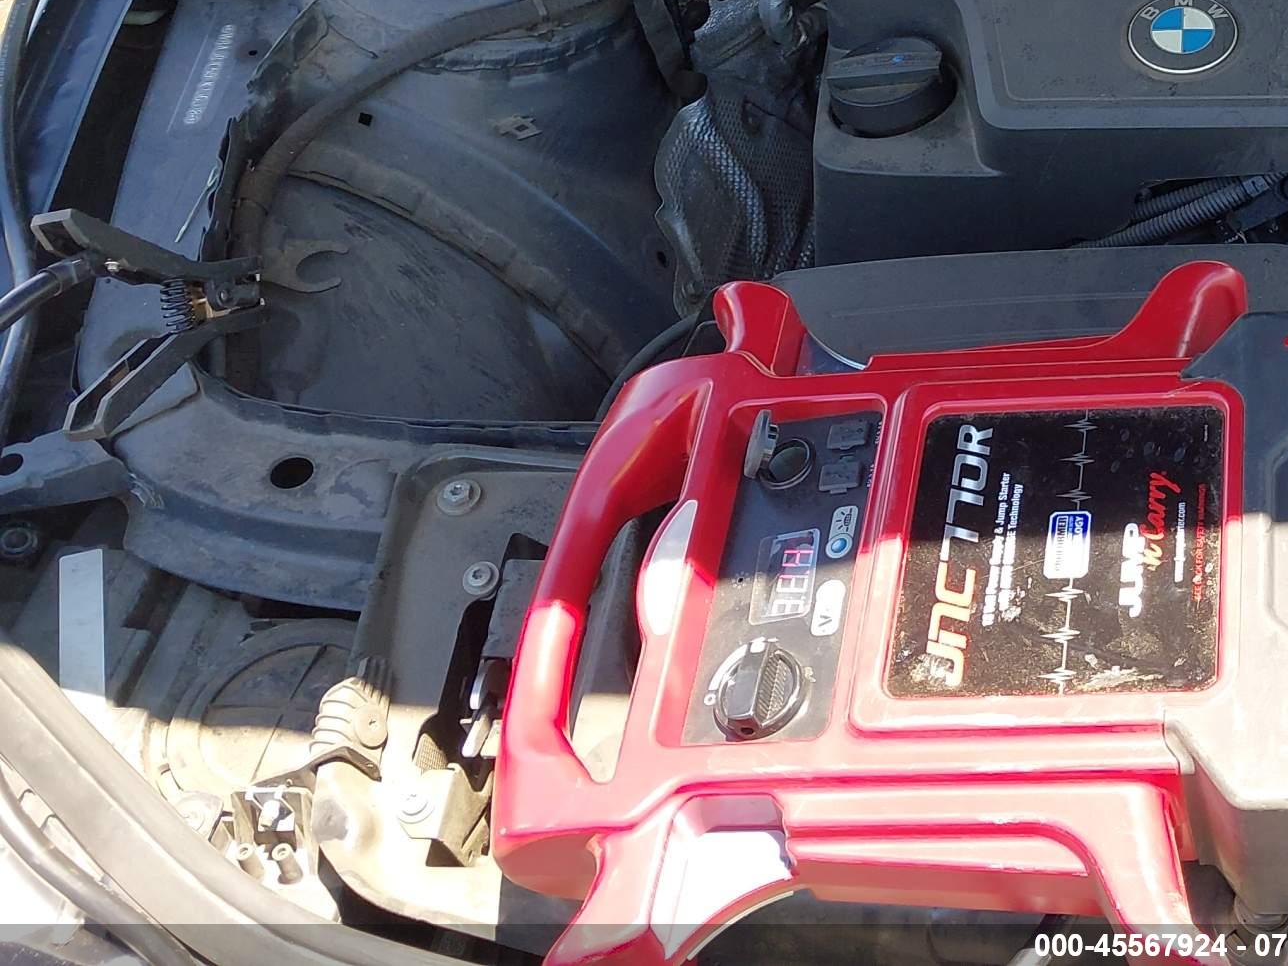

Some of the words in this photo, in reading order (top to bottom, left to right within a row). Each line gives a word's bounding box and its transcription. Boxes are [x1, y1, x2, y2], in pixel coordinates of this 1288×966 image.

[998, 472, 1011, 501] Starter
[996, 502, 1008, 526] Jump
[1007, 484, 1024, 530] Technology
[1139, 472, 1181, 540] Carry
[994, 526, 1004, 534] &
[1118, 523, 1146, 618] JUMP
